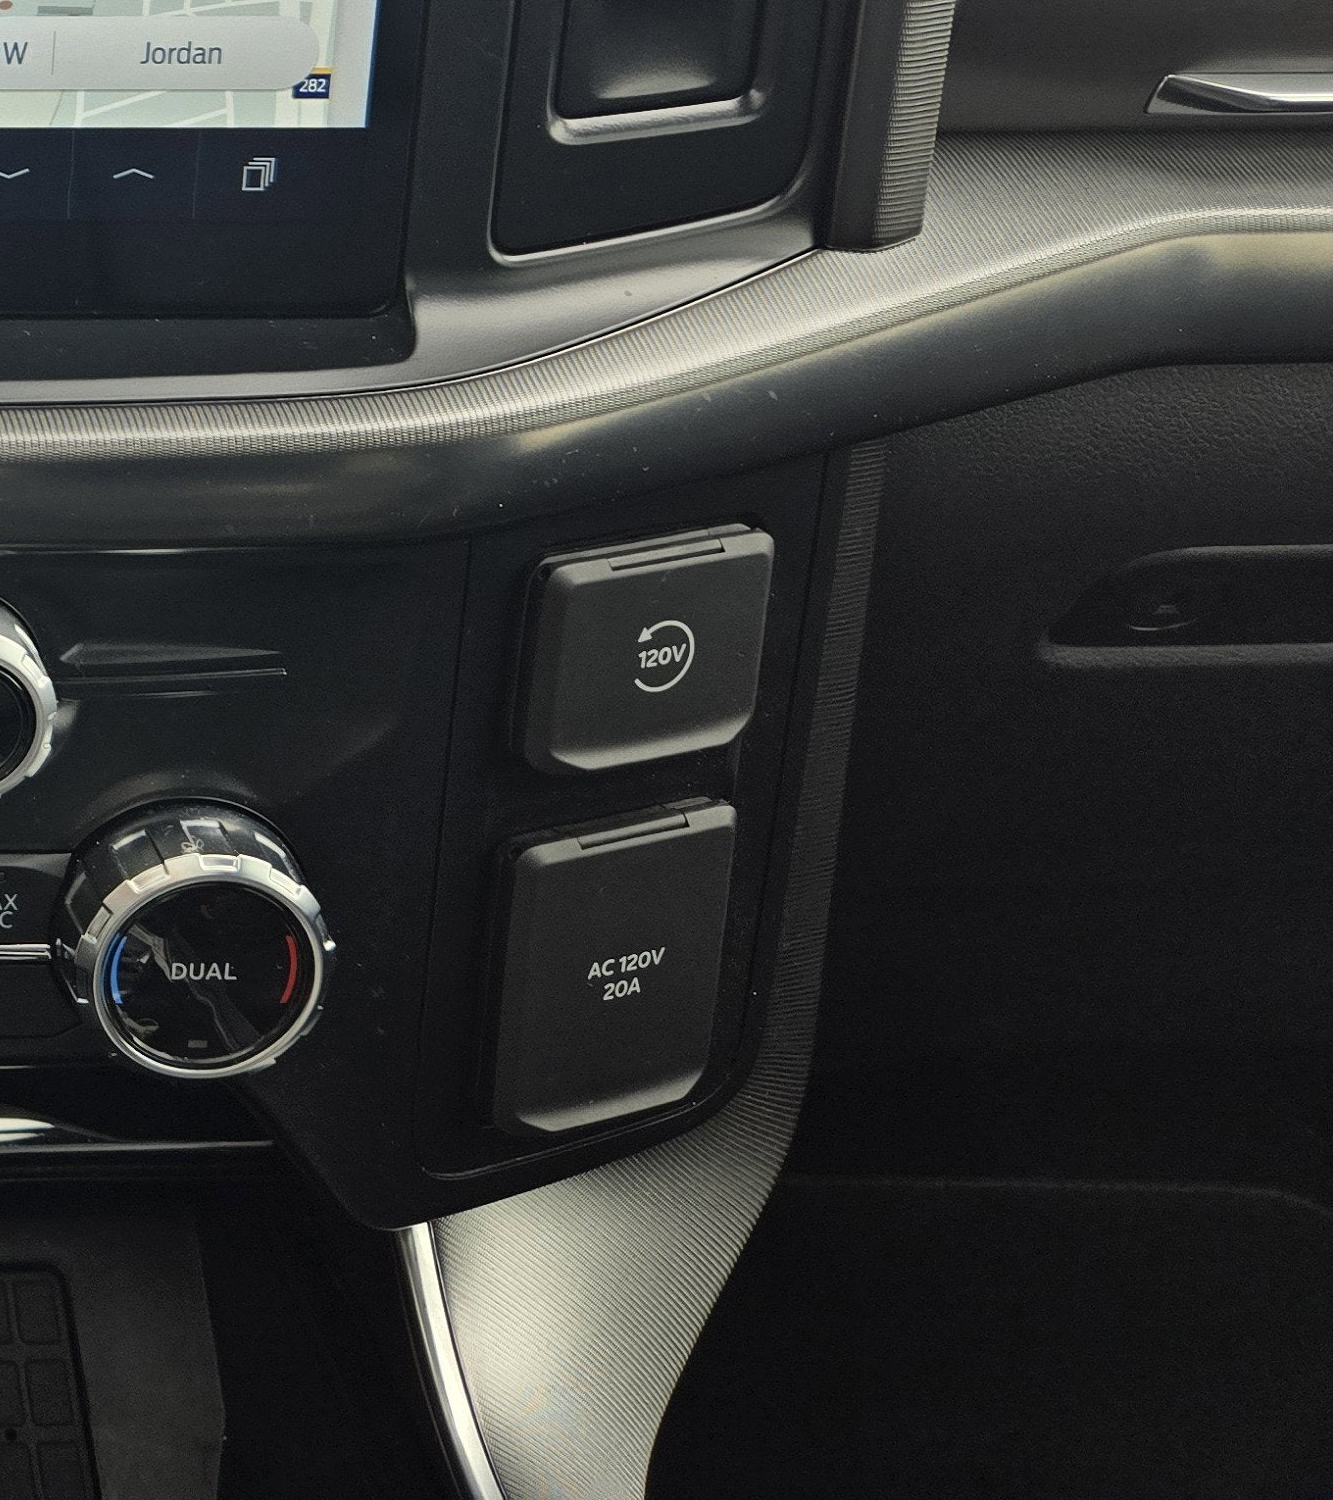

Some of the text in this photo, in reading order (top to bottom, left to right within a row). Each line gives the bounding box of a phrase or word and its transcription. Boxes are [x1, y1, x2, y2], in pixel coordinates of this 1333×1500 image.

[2, 41, 223, 66] W Jordan
[299, 77, 327, 95] 282
[638, 643, 686, 669] 120V
[171, 962, 237, 981] DUAL
[587, 947, 665, 980] AC 120V
[602, 977, 641, 1001] 20A
